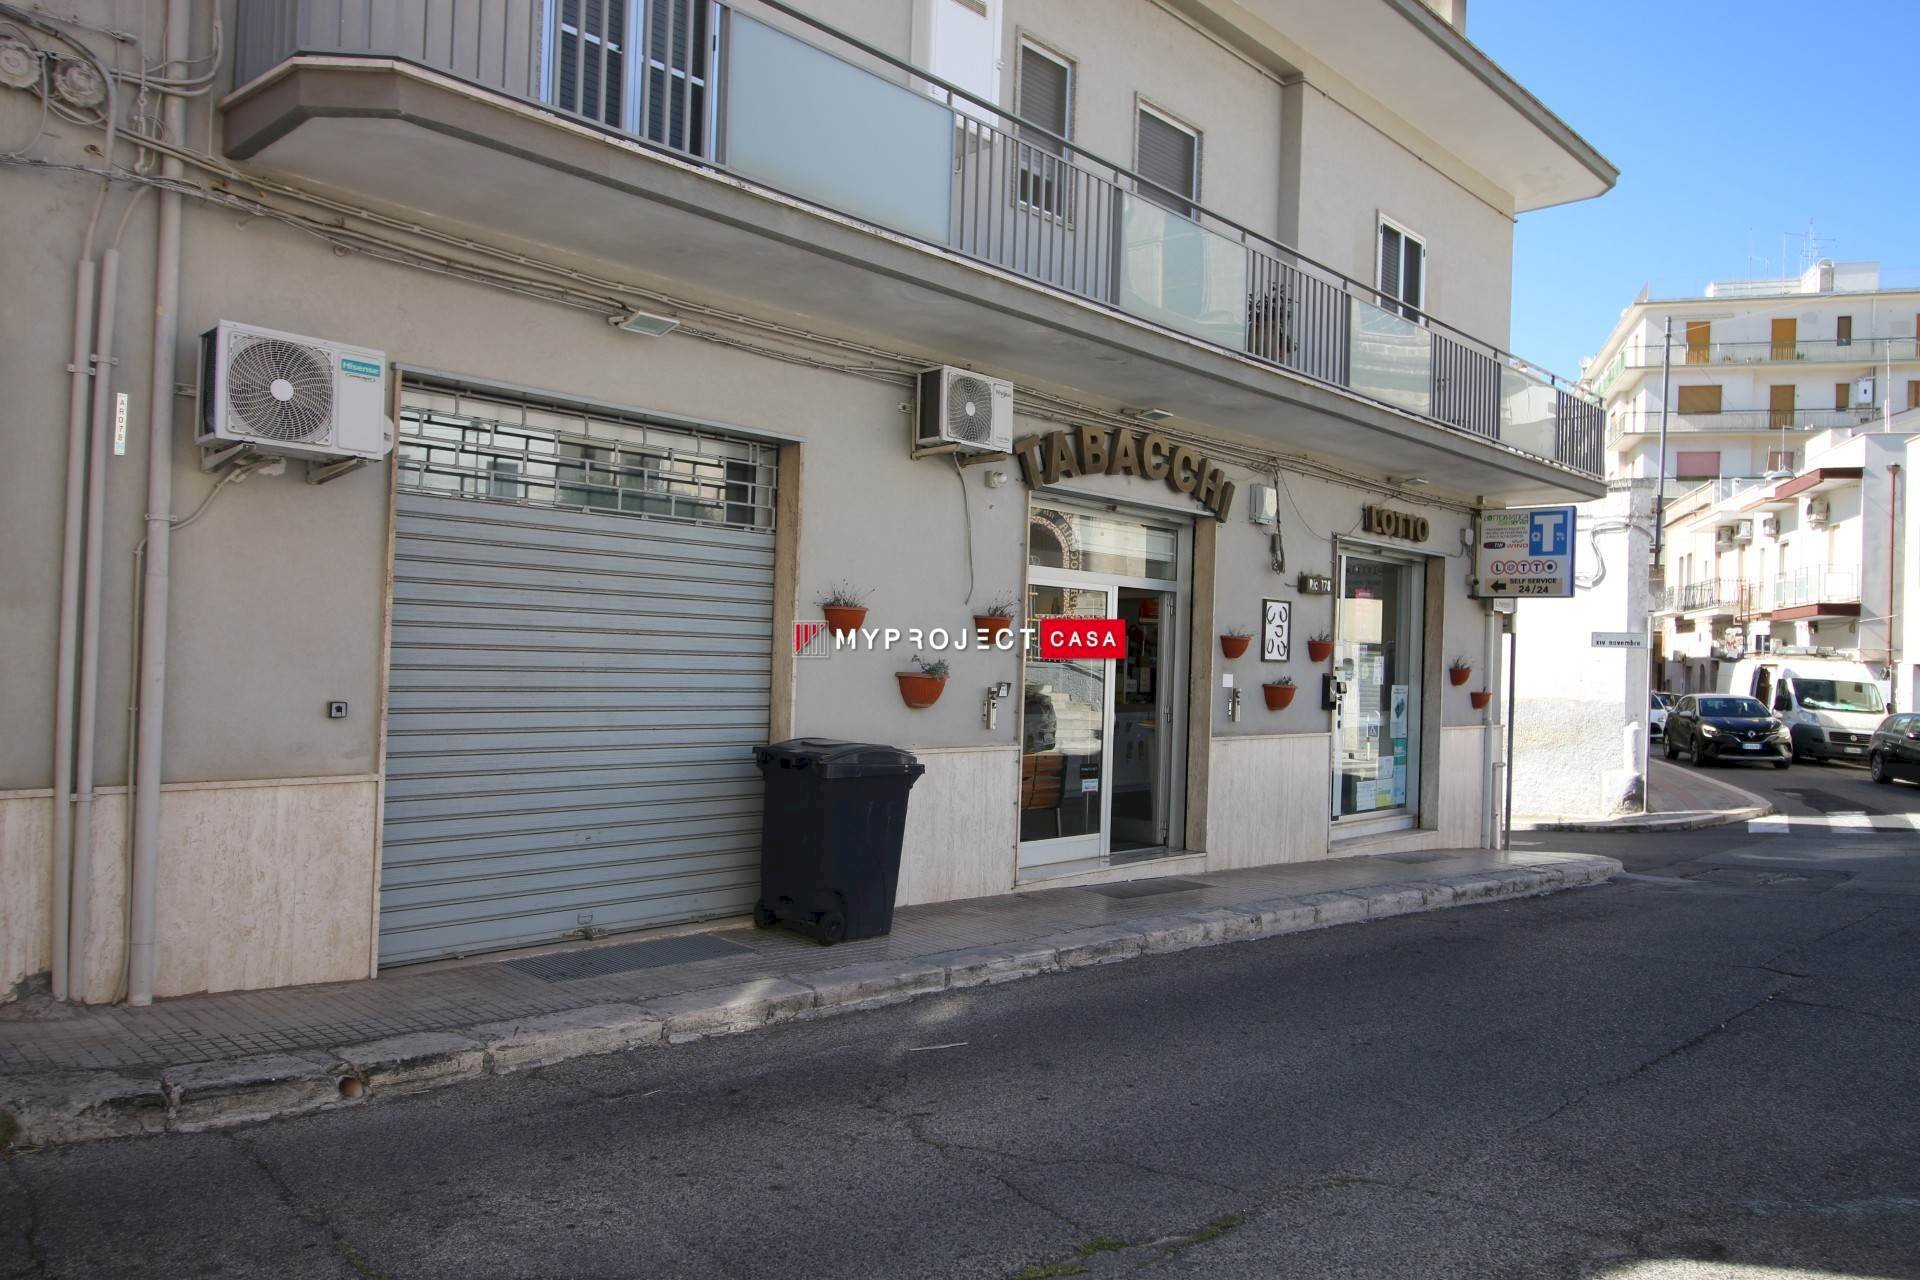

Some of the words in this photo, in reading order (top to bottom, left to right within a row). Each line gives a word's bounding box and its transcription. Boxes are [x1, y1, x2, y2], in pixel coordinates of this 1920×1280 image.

[342, 361, 380, 375] Hisense
[1015, 424, 1235, 523] TABACCHI
[1364, 504, 1431, 543] LOTTO
[1534, 514, 1564, 552] T
[1491, 560, 1557, 575] LOTTO
[1518, 584, 1549, 594] 24/24
